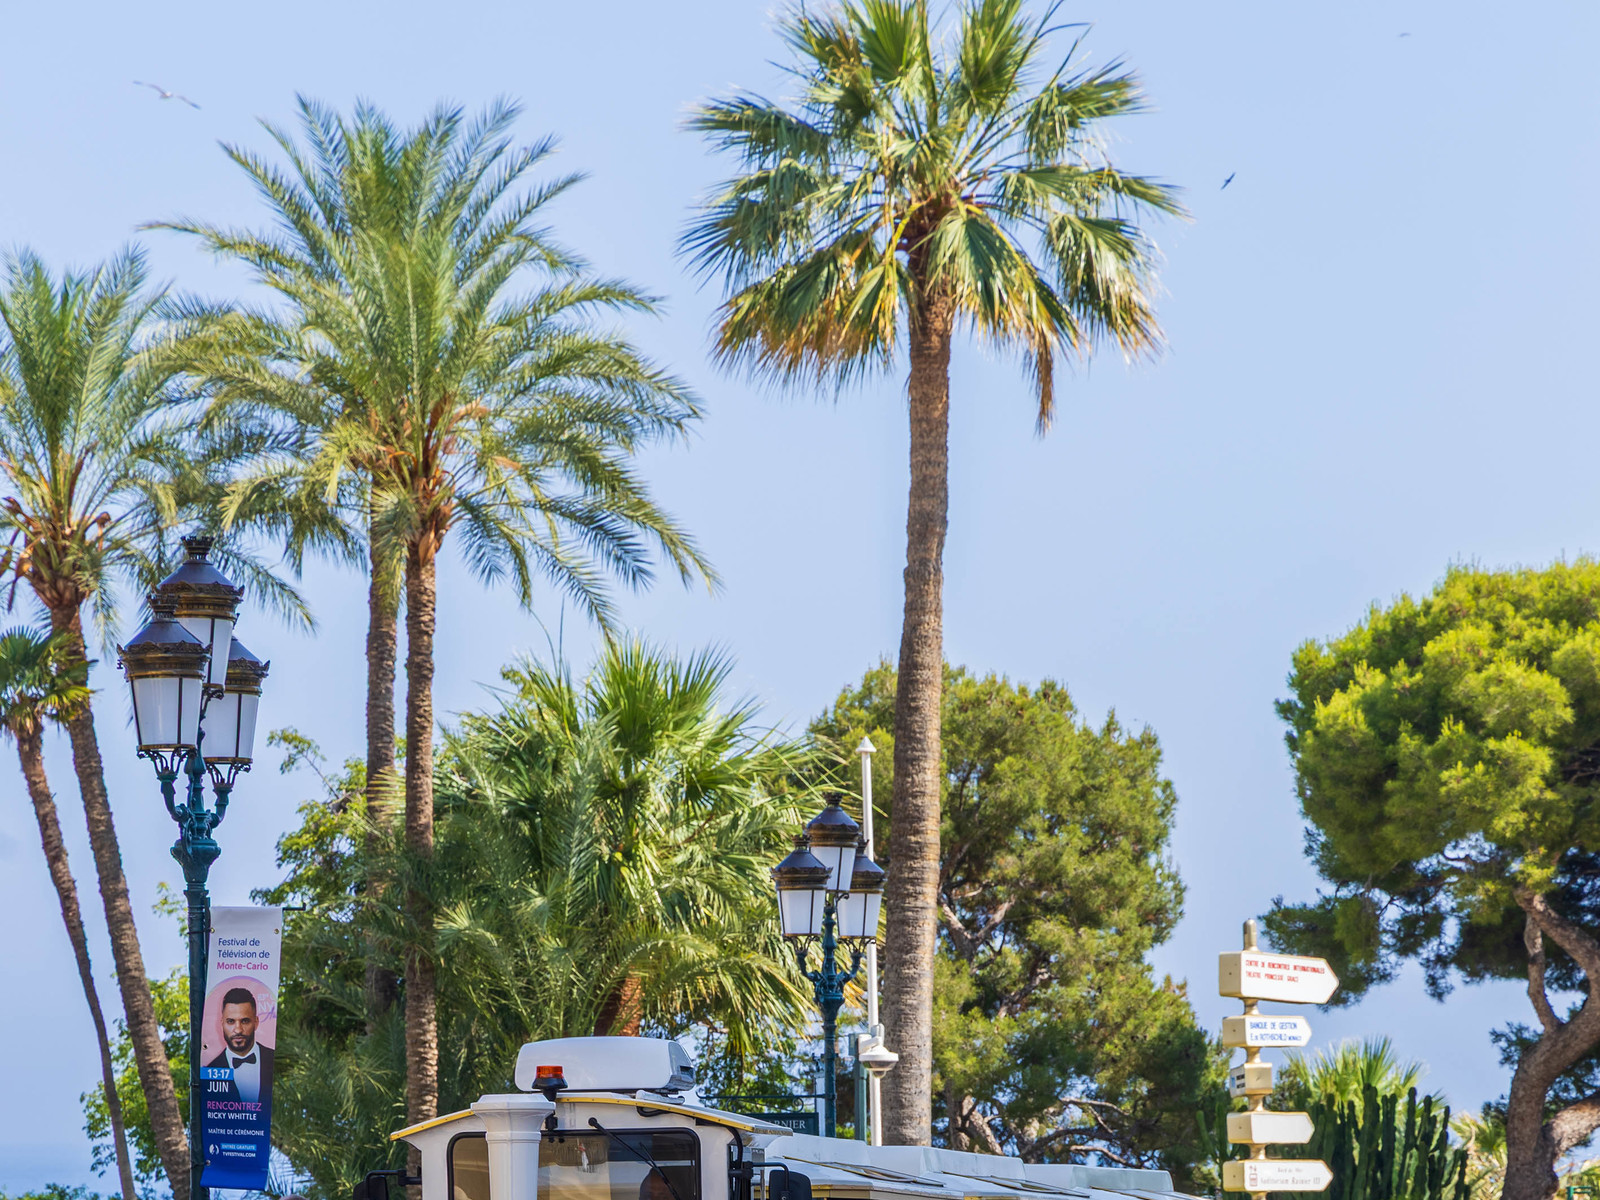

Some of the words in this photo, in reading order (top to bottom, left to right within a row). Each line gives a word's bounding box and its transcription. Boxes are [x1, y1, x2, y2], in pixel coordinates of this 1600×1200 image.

[218, 937, 247, 947] Festival
[249, 938, 261, 947] de
[218, 949, 257, 959] Télévision
[258, 950, 271, 959] de
[216, 961, 269, 971] Monte-Carlo
[207, 1069, 230, 1079] 13-17
[207, 1081, 229, 1093] JUIN
[207, 1101, 262, 1111] RENCONTREZ
[207, 1111, 227, 1120] RICKY
[227, 1112, 257, 1121] WHITTLE
[208, 1127, 226, 1135] MAÎTRE
[234, 1128, 265, 1136] CÉRÉMONIE
